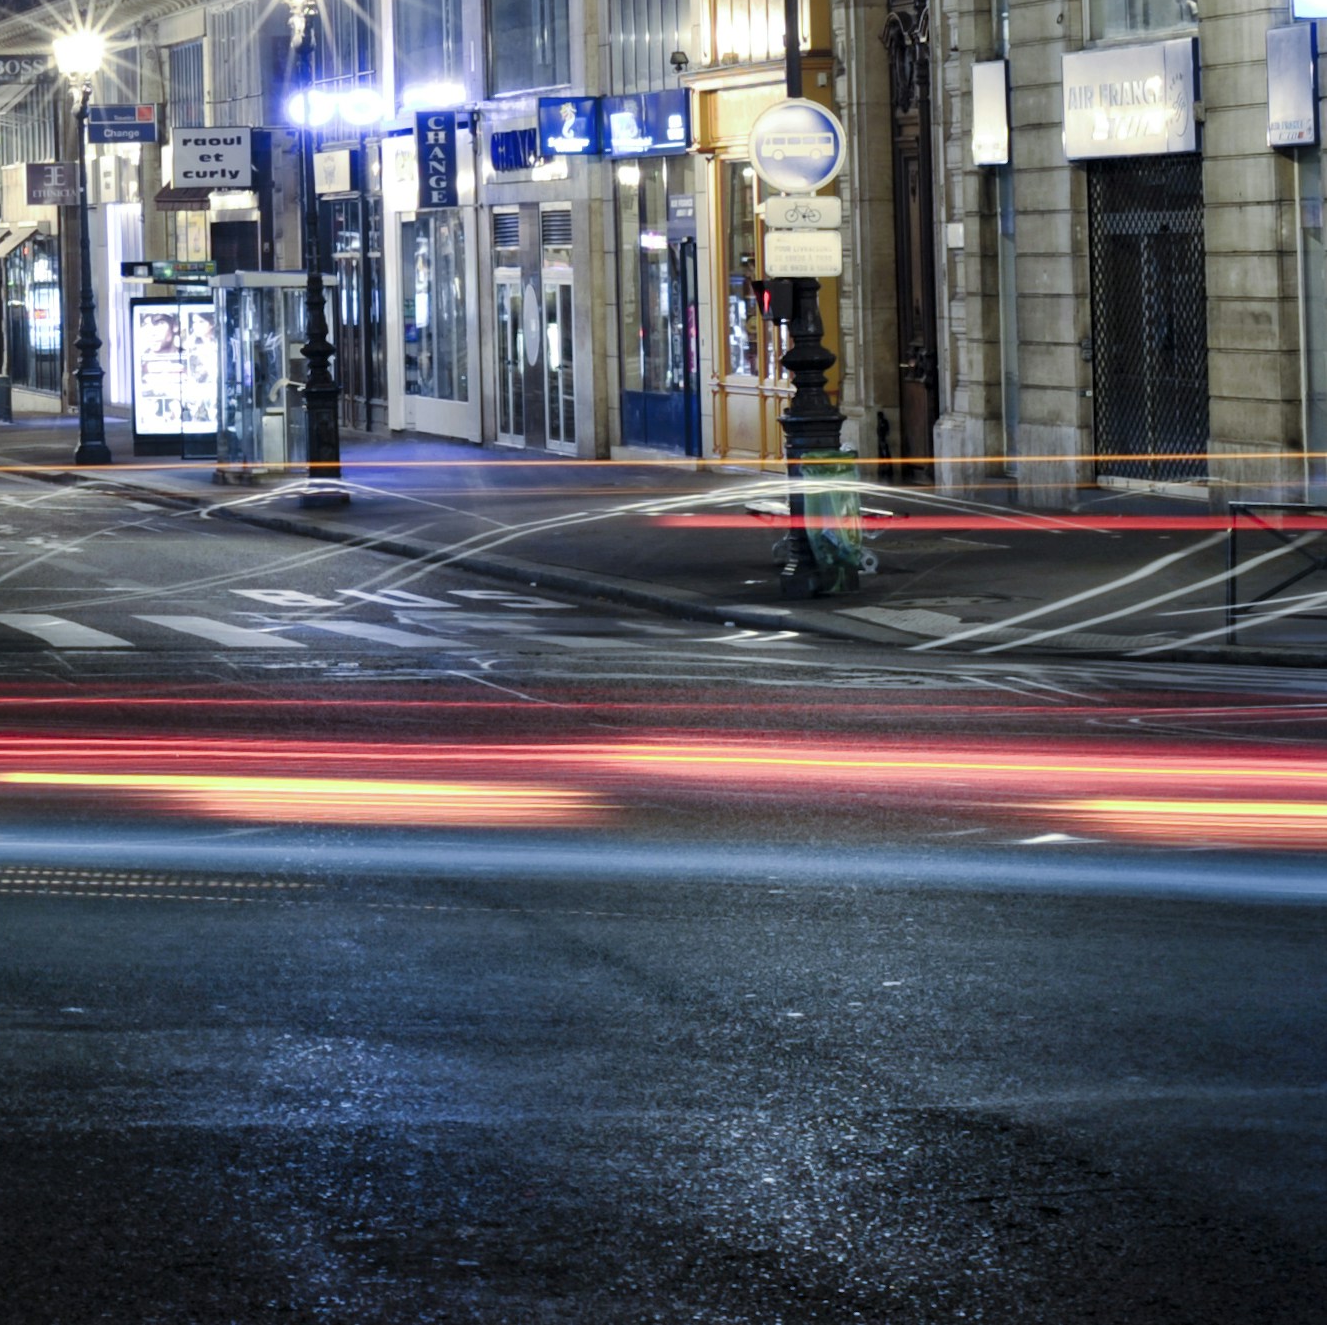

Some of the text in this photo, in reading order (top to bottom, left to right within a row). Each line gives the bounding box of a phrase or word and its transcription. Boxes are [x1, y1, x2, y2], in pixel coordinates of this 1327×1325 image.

[1067, 86, 1094, 110] AIR
[103, 124, 140, 139] Change
[182, 136, 242, 146] raoul
[199, 153, 224, 162] et
[425, 116, 447, 204] CHANGE
[182, 169, 240, 179] curly
